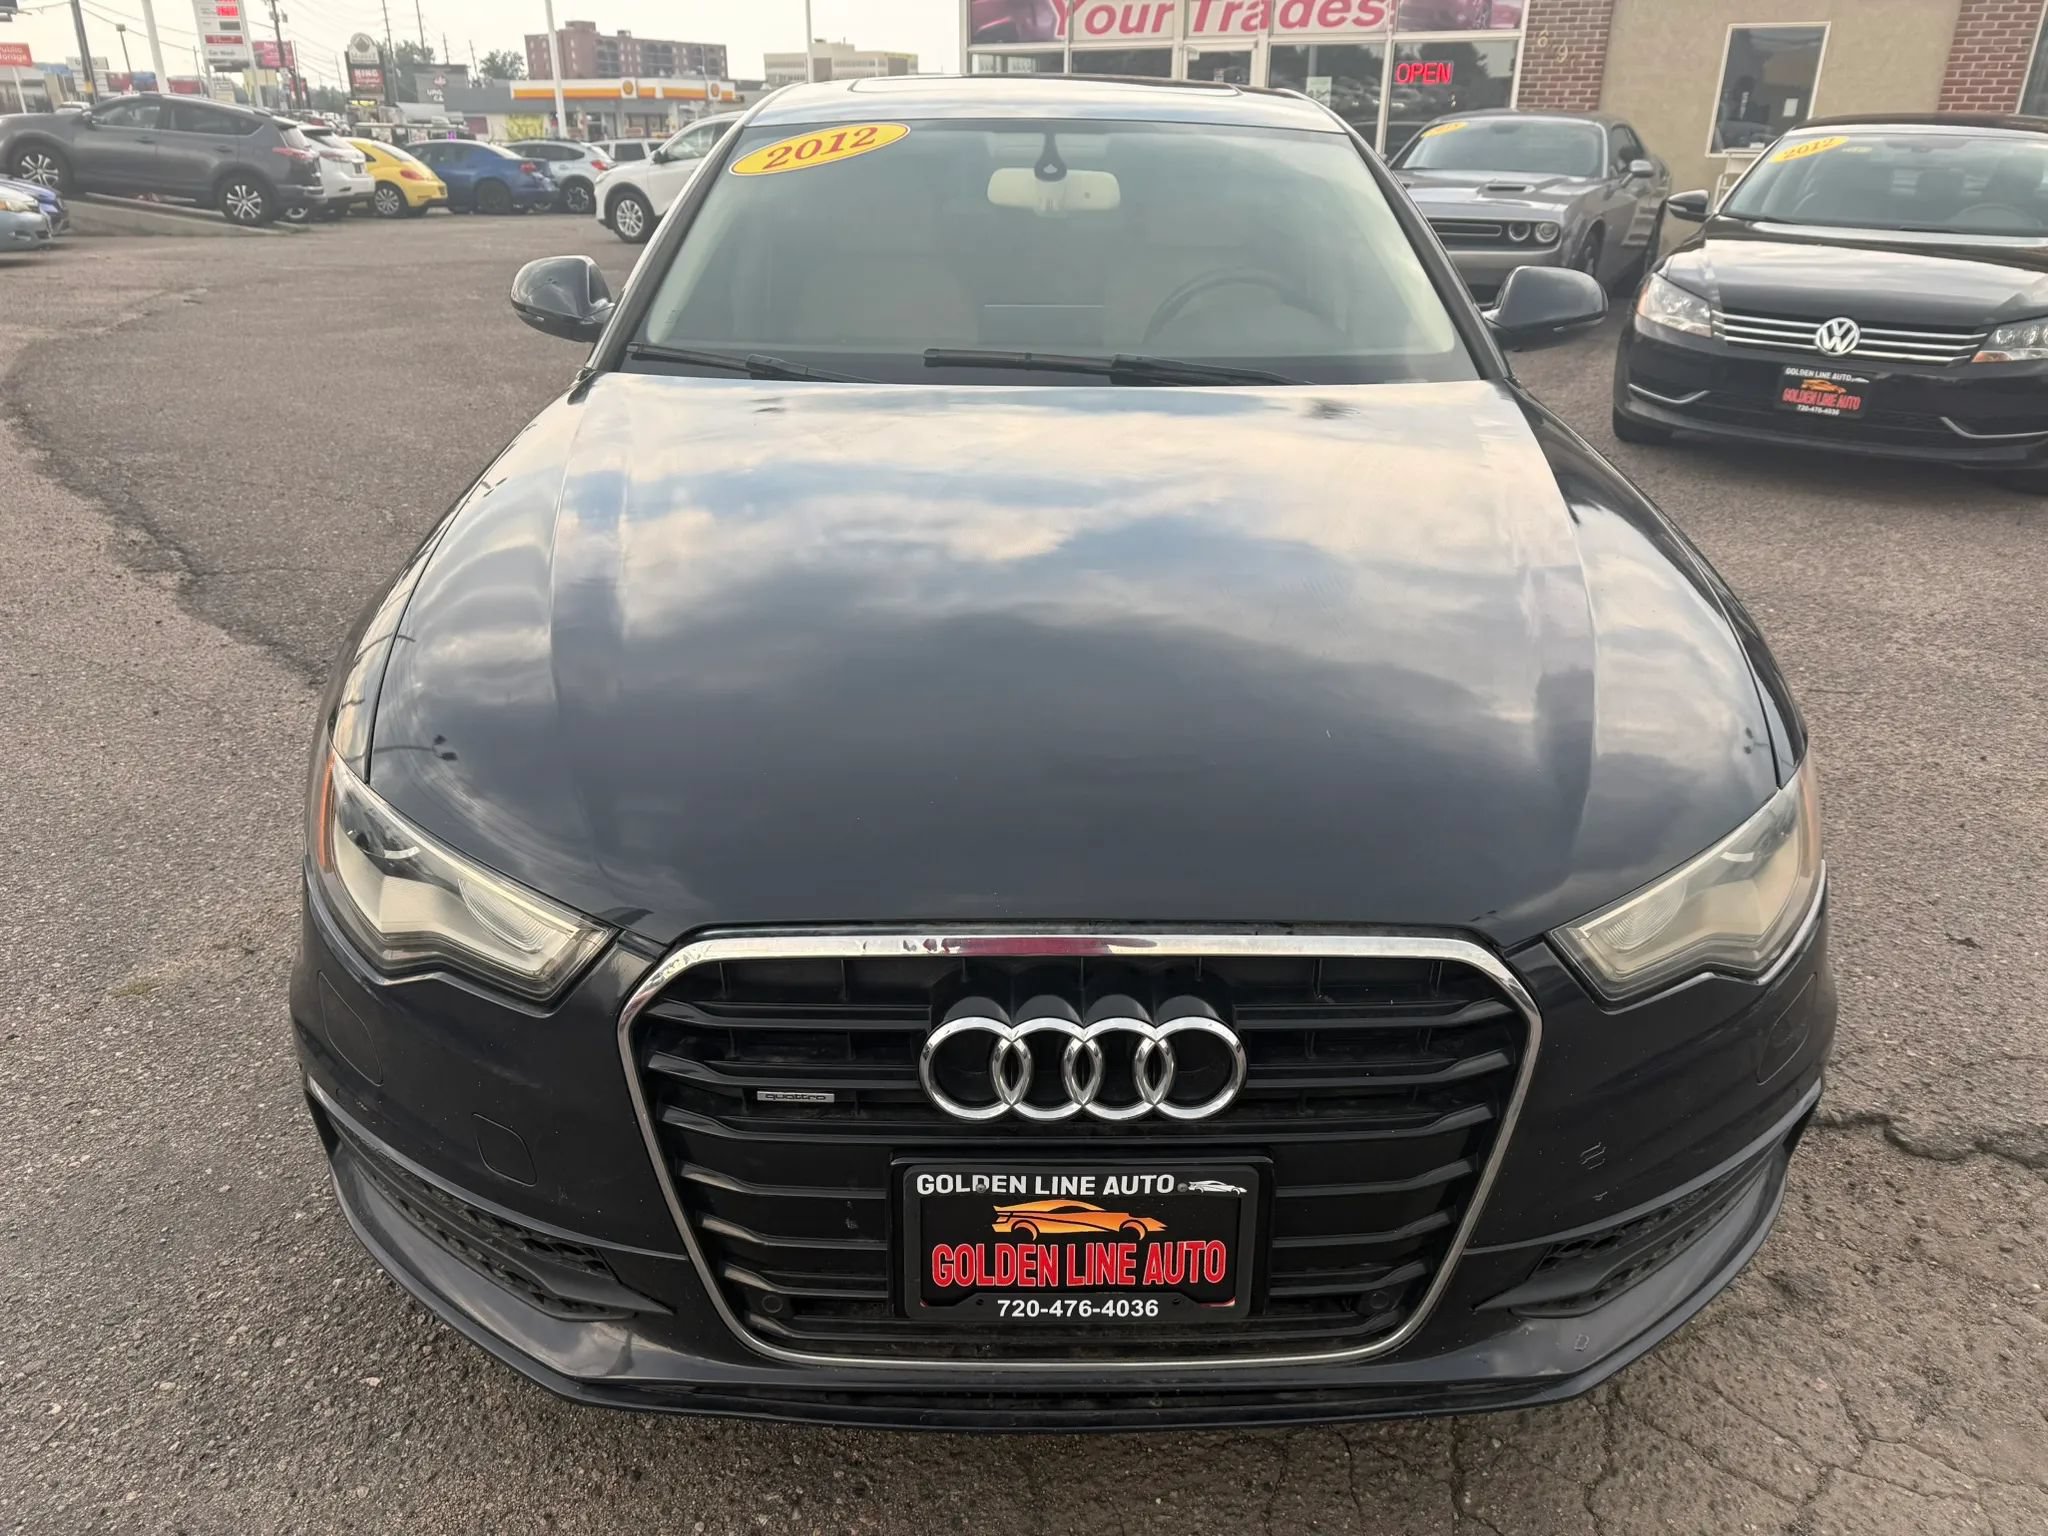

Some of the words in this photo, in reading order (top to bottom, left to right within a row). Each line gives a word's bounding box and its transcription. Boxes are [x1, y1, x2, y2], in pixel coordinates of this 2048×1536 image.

[1052, 0, 1174, 36] Your
[1394, 62, 1453, 85] OPEN
[762, 127, 878, 170] 2012
[1785, 367, 1815, 377] GOLDEN
[1815, 370, 1832, 379] LINE
[1832, 373, 1852, 381] AUTO
[1782, 388, 1817, 405] GOLDEN
[1816, 391, 1838, 407] LINE
[1836, 394, 1861, 410] AUTO
[765, 1093, 826, 1101] quattro
[916, 1174, 1027, 1195] GOLDEN
[1035, 1175, 1096, 1196] LINE
[1103, 1174, 1175, 1195] AUTO
[931, 1243, 1059, 1287] GOLDEN
[1066, 1242, 1137, 1286] LINE
[1142, 1240, 1227, 1286] AUTO
[997, 1300, 1159, 1318] 720-476-4036
